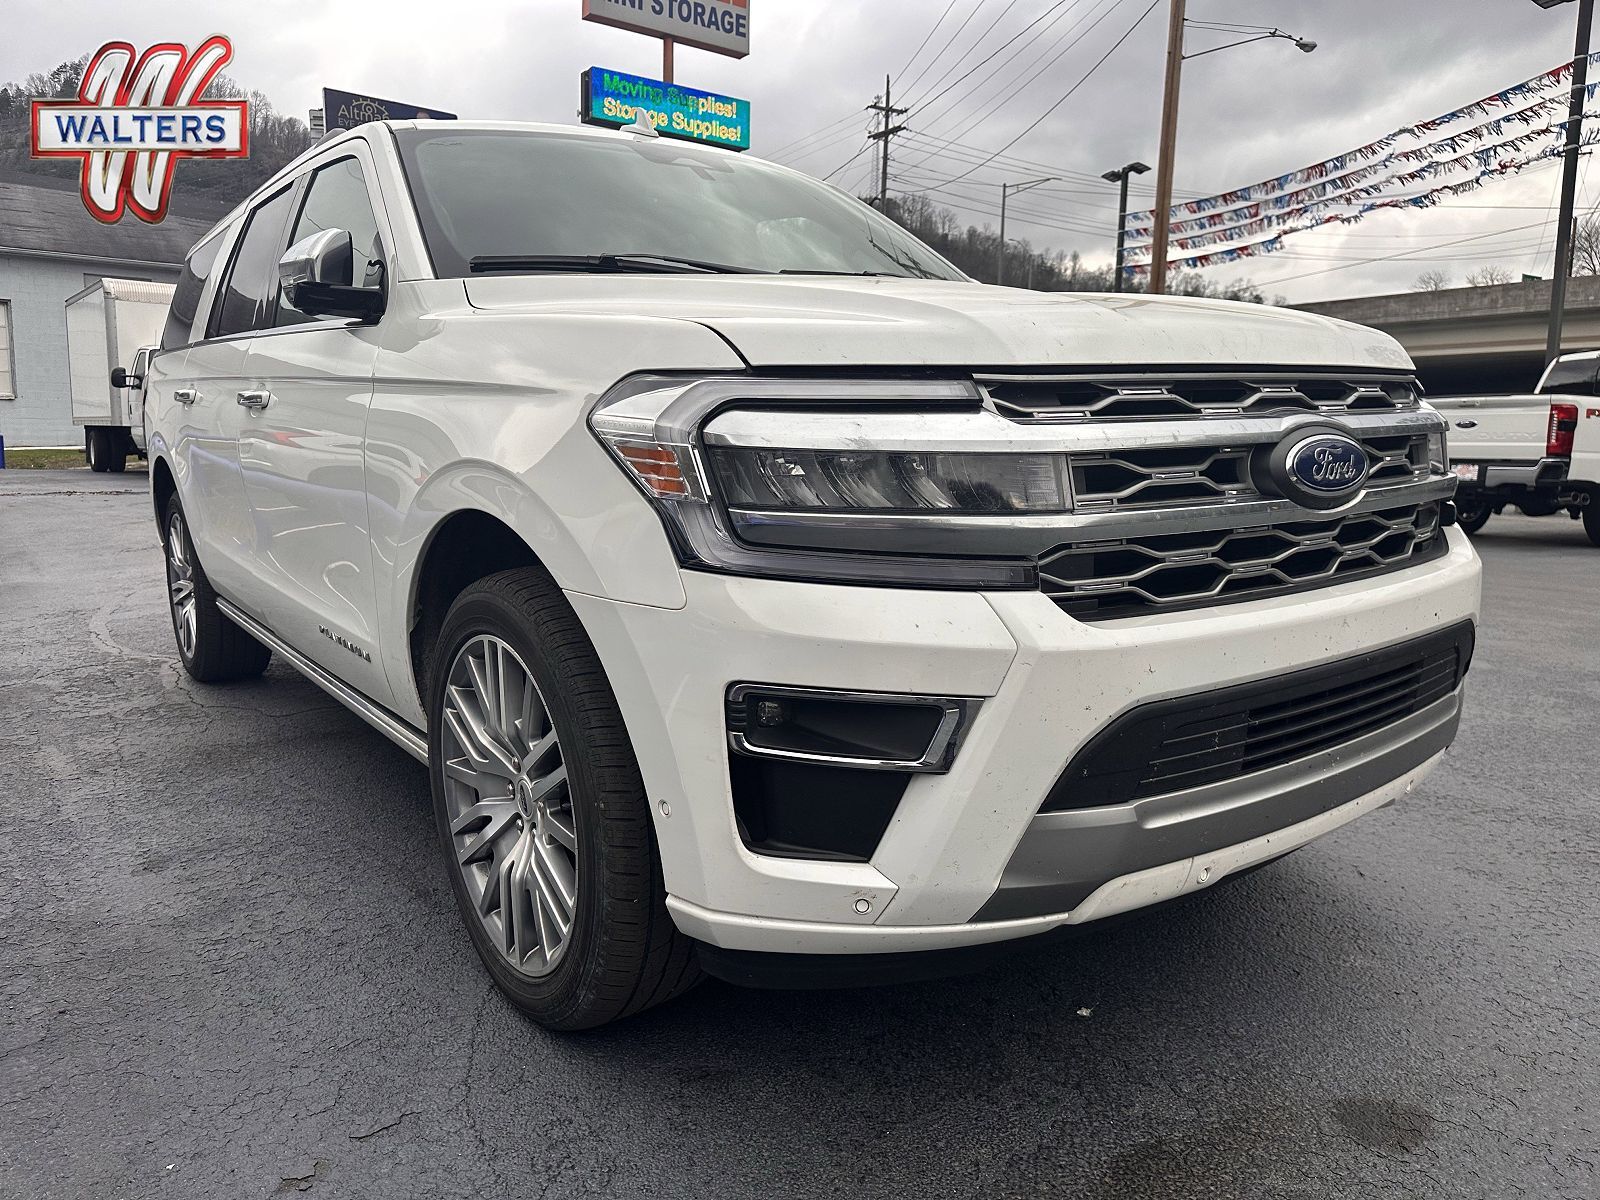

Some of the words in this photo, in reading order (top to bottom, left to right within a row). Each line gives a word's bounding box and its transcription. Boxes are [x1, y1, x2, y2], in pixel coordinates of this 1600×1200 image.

[651, 0, 747, 38] STORAGE
[603, 73, 663, 106] Moving
[668, 87, 737, 119] Supplies!
[338, 117, 355, 127] EYE
[603, 97, 669, 128] Storge
[672, 112, 741, 142] Supplies!
[1313, 447, 1356, 480] Ford
